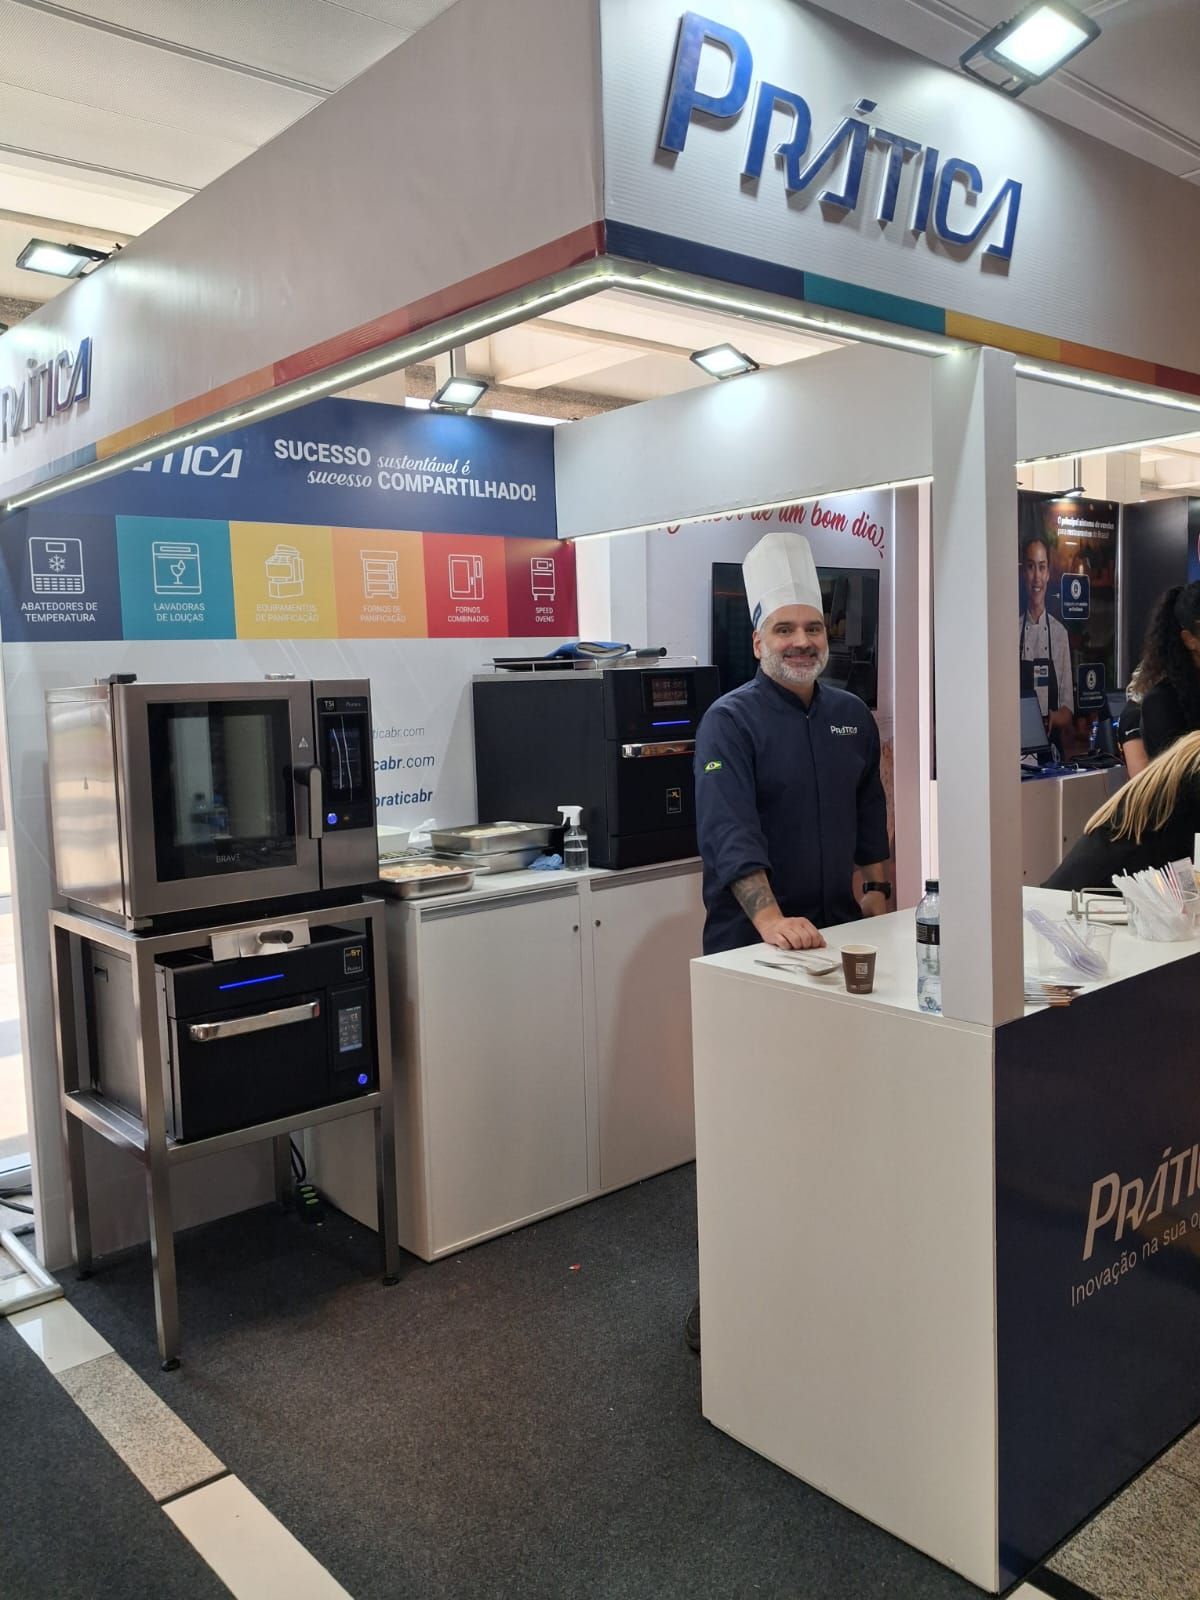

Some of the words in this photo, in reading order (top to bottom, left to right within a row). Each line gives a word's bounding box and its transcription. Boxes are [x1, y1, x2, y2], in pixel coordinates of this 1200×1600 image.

[659, 11, 1022, 261] PRÁTICA
[274, 439, 371, 467] SUCESSO
[377, 454, 459, 474] sustentável
[462, 459, 471, 476] é
[307, 469, 372, 488] sucesso
[377, 471, 537, 502] COMPARTILHADO!
[811, 500, 849, 533] bom
[21, 601, 84, 612] ABATEDORES
[86, 601, 98, 612] DE
[153, 602, 205, 612] LAVADORAS
[256, 603, 317, 613] EQUIPAMENTOS
[363, 604, 391, 614] FORNOS
[393, 604, 401, 614] DE
[455, 606, 481, 614] FORNOS
[535, 607, 554, 615] SPEED
[24, 612, 96, 623] TEMPERATURA
[156, 613, 169, 622] DE
[170, 612, 204, 624] LOUÇAS
[255, 613, 267, 623] DE
[268, 612, 319, 624] PANIFICAÇÃO
[360, 612, 406, 624] PANIFICAÇÃO
[447, 615, 490, 624] COMBINADOS
[535, 615, 555, 624] OVENS
[1082, 1143, 1200, 1262] PRÁTI
[1071, 1249, 1137, 1308] Inovação
[1142, 1237, 1159, 1261] na
[1163, 1220, 1187, 1246] sua
